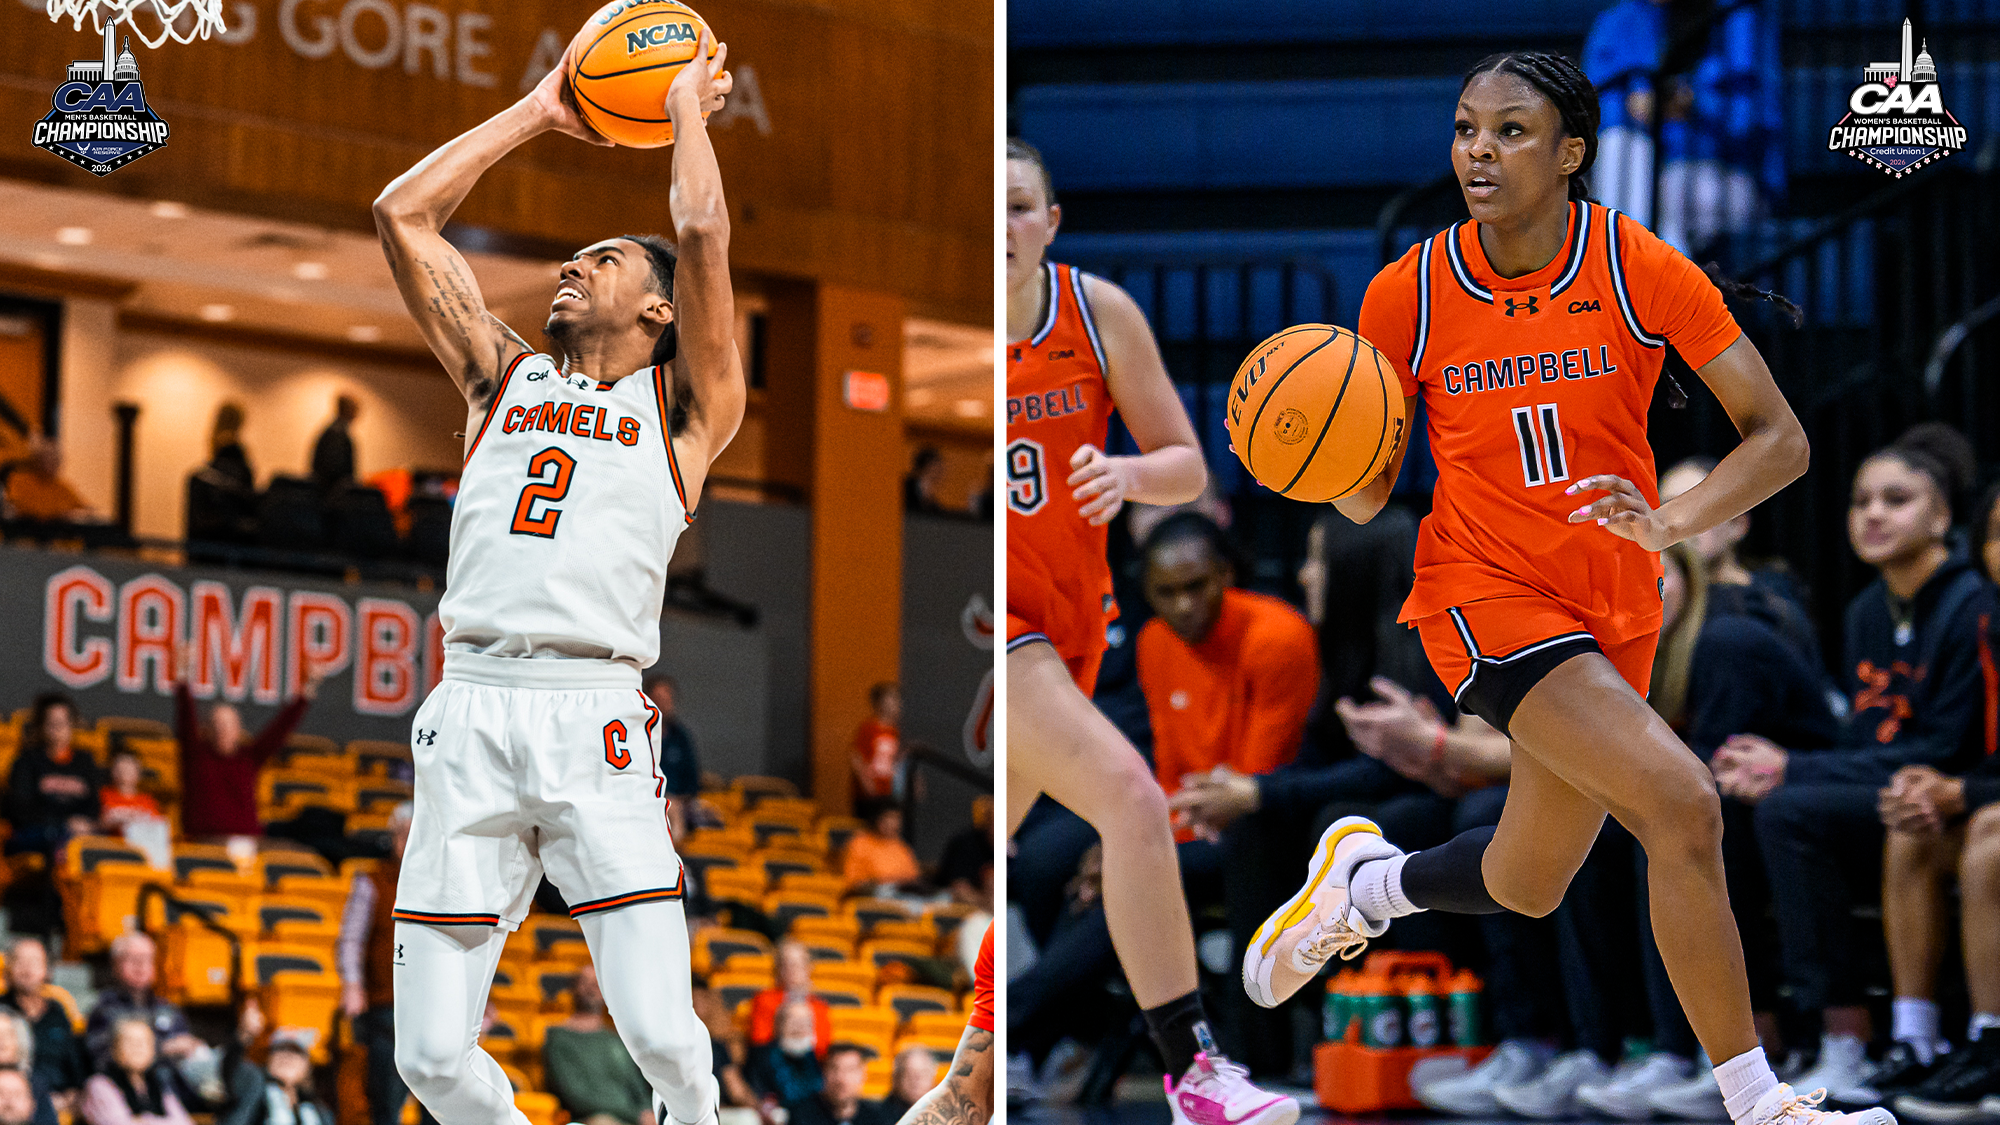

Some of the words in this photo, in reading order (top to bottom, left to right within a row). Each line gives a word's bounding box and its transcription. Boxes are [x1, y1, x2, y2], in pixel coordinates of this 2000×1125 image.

[277, 0, 498, 88] GORE
[626, 22, 697, 54] NCAA
[1567, 299, 1602, 315] CAA
[526, 369, 550, 382] CAA
[1231, 356, 1268, 426] EVO
[1266, 340, 1287, 358] NXT
[1442, 345, 1617, 396] CAMPBELL
[502, 401, 641, 447] CAMELS
[1511, 402, 1570, 488] 11
[509, 445, 578, 539] 2
[43, 565, 444, 716] CAMPB
[603, 719, 632, 770] C
